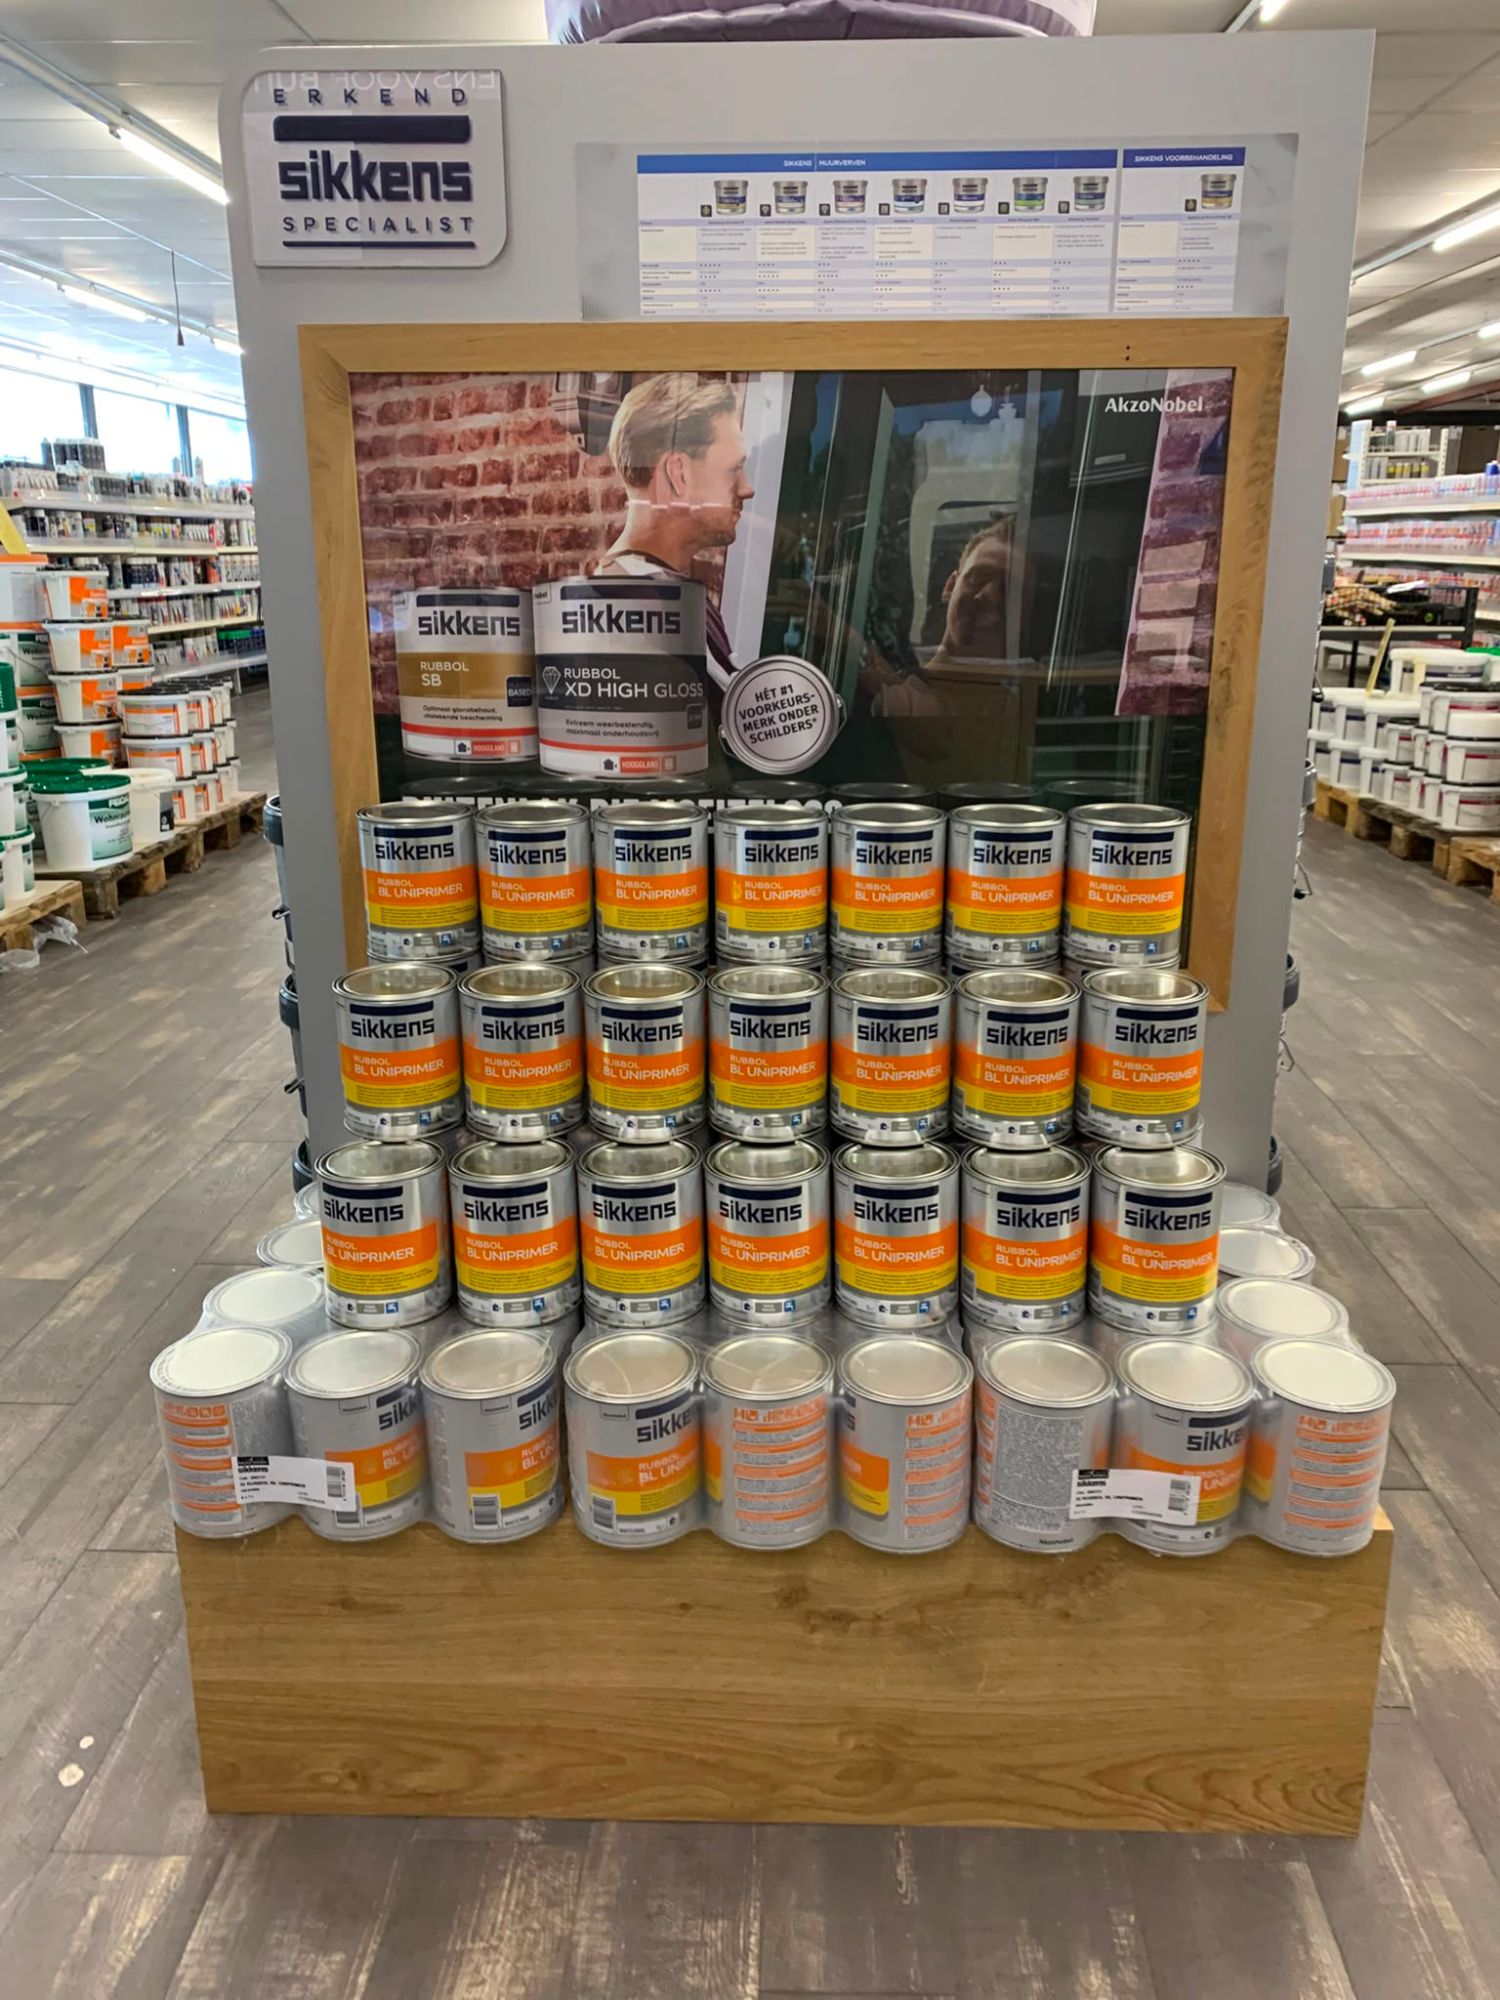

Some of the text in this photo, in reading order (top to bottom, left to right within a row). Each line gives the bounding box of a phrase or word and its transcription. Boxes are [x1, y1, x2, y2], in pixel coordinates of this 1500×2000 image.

[273, 88, 466, 104] ERKEND
[783, 158, 866, 167] SIKKENS MUURVERVEN
[1134, 153, 1233, 163] SIKKENS VOORBEHANDELING
[278, 150, 473, 201] sikkens
[282, 216, 473, 233] SPECIALIST
[1104, 396, 1203, 413] AkzoNobel
[418, 610, 520, 636] sikkens
[562, 603, 681, 634] sikkens
[420, 661, 469, 672] RUBBOL
[564, 668, 621, 680] RUBBOL
[421, 674, 442, 687] SB
[565, 682, 703, 698] XD HIGH GLOSS
[755, 684, 794, 702] HÉT #1
[739, 692, 815, 720] VOORKEURS-
[743, 704, 819, 733] MERK ONDER
[375, 841, 454, 861] sikkens
[489, 844, 566, 865] sikkens
[615, 843, 692, 863] sikkens
[745, 845, 819, 864] sikkens
[856, 845, 933, 865] sikkens
[973, 845, 1052, 865] sikkens
[1092, 845, 1173, 866] sikkens
[378, 878, 414, 889] RUBBOL
[378, 883, 463, 898] BL UNIPRIMER
[491, 880, 527, 891] RUBBOL
[616, 879, 653, 890] RUBBOL
[745, 880, 781, 891] RUBBOL
[855, 881, 892, 892] RUBBOL
[971, 881, 1010, 892] RUBBOL
[1089, 881, 1128, 893] RUBBOL
[491, 887, 575, 902] BL UNIPRIMER
[616, 885, 697, 900] BL UNIPRIMER
[745, 886, 823, 901] BL UNIPRIMER
[855, 888, 936, 902] BL UNIPRIMER
[971, 889, 1054, 904] BL UNIPRIMER
[1088, 890, 1174, 904] BL UNIPRIMER
[351, 1018, 434, 1039] sikkens
[482, 1018, 565, 1040] sikkens
[602, 1022, 683, 1042] sikkens
[730, 1018, 811, 1039] sikkens
[857, 1021, 938, 1043] sikkens
[986, 1025, 1068, 1046] sikkens
[1115, 1023, 1197, 1044] sikkens
[354, 1054, 391, 1065] RUBBOL
[354, 1059, 445, 1077] BL UNIPRIMER
[484, 1056, 523, 1067] RUBBOL
[603, 1057, 640, 1069] RUBBOL
[730, 1054, 768, 1066] RUBBOL
[856, 1059, 896, 1070] RUBBOL
[985, 1062, 1026, 1073] RUBBOL
[1113, 1060, 1155, 1071] RUBBOL
[484, 1059, 572, 1078] BL UNIPRIMER
[603, 1063, 690, 1080] BL UNIPRIMER
[730, 1061, 816, 1077] BL UNIPRIMER
[856, 1064, 942, 1081] BL UNIPRIMER
[984, 1068, 1070, 1085] BL UNIPRIMER
[1112, 1066, 1198, 1083] BL UNIPRIMER
[323, 1199, 403, 1223] sikkens
[464, 1199, 548, 1222] sikkens
[592, 1200, 676, 1222] sikkens
[720, 1200, 802, 1223] sikkens
[854, 1201, 938, 1223] sikkens
[997, 1205, 1080, 1228] sikkens
[1124, 1208, 1211, 1231] sikkens
[326, 1235, 356, 1250] RUBBOL
[466, 1237, 503, 1249] RUBBOL
[594, 1236, 631, 1249] RUBBOL
[720, 1235, 756, 1250] RUBBOL
[854, 1236, 893, 1250] RUBBOL
[996, 1244, 1039, 1256] RUBBOL
[1122, 1244, 1166, 1258] RUBBOL
[327, 1247, 414, 1262] BL UNIPRIMER
[467, 1242, 558, 1261] BL UNIPRIMER
[595, 1242, 685, 1261] BL UNIPRIMER
[720, 1245, 810, 1262] BL UNIPRIMER
[854, 1246, 945, 1262] BL UNIPRIMER
[996, 1247, 1082, 1268] BL UNIPRIMER
[1121, 1251, 1213, 1270] BL UNIPRIMER
